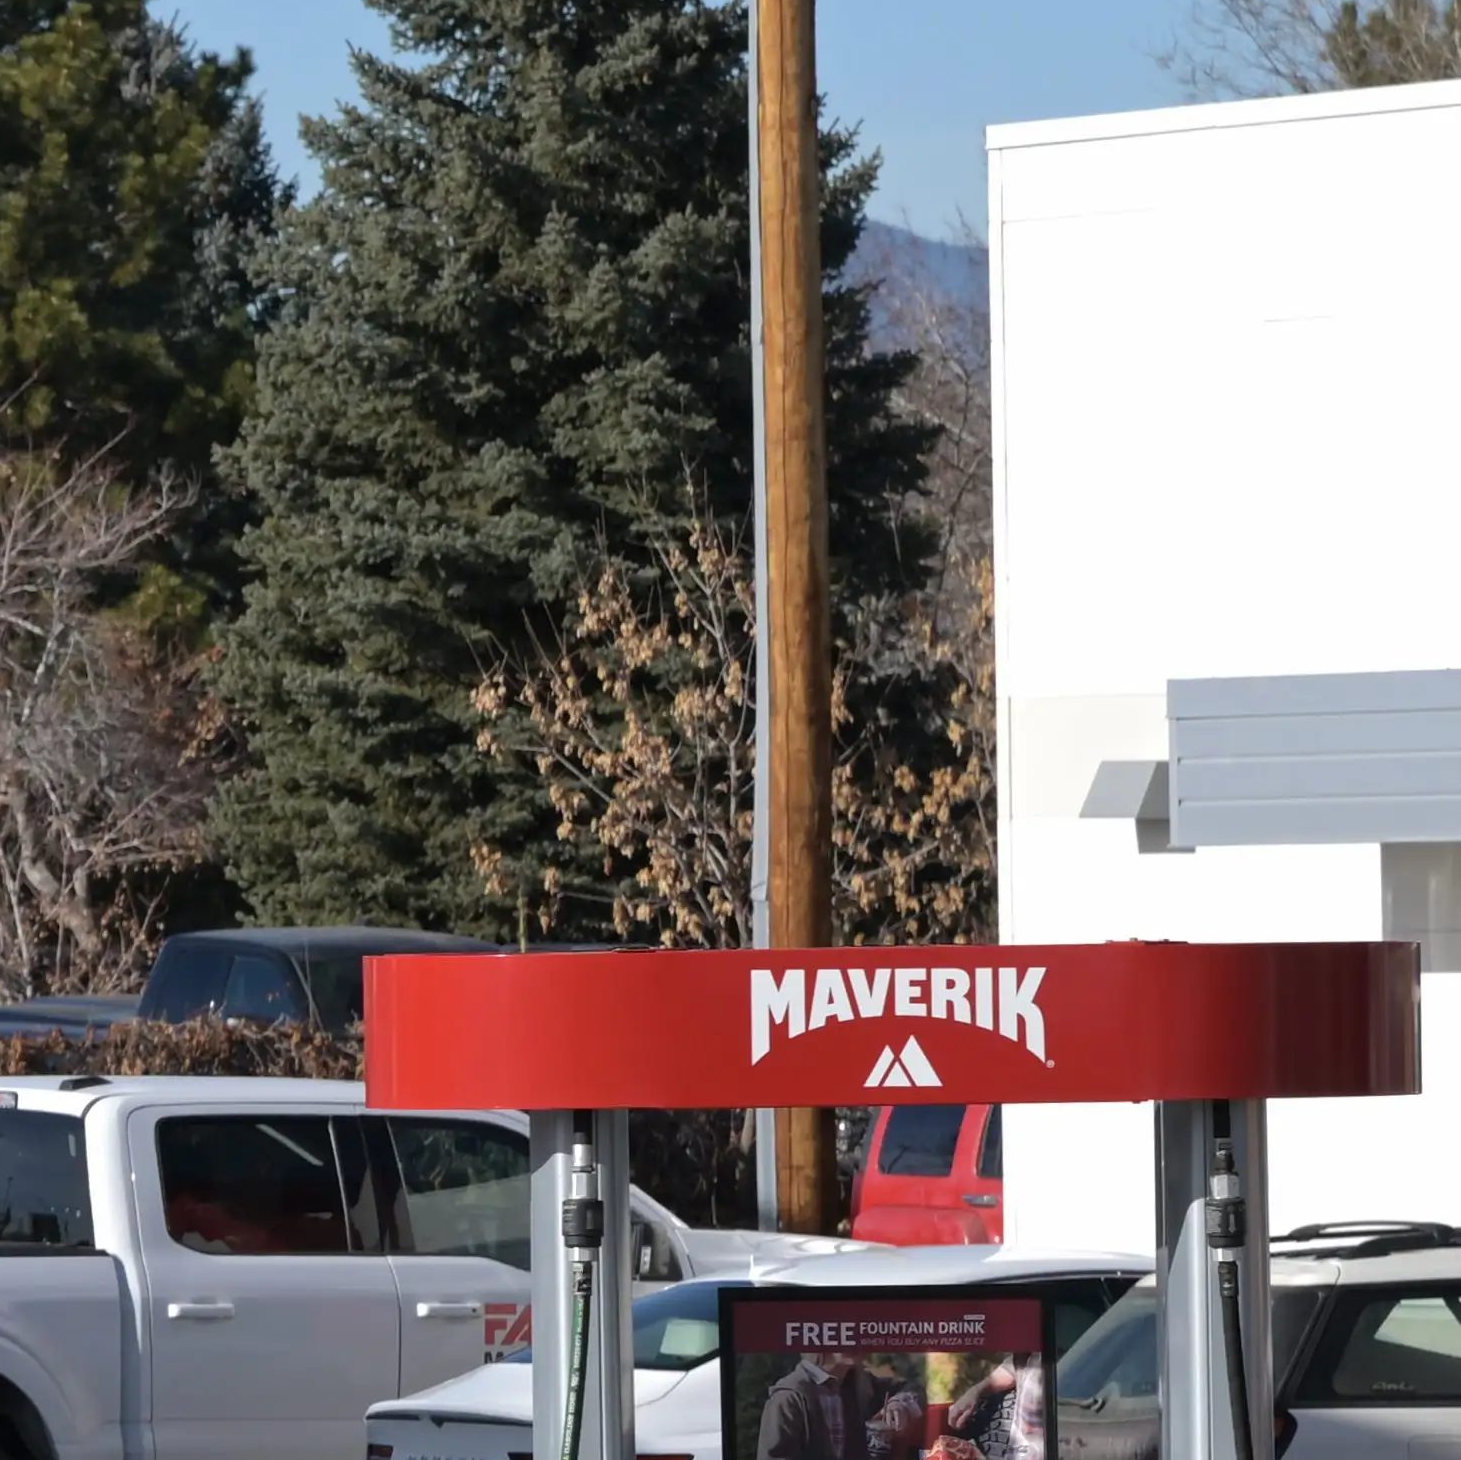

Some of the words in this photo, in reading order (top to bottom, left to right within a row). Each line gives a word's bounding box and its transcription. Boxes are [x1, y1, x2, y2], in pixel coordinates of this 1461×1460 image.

[750, 966, 1049, 1065] MAVERIK
[485, 1303, 532, 1345] FA
[786, 1322, 856, 1346] FREE
[859, 1321, 934, 1335] FOUNTAIN
[938, 1321, 986, 1334] DRINK
[921, 1337, 940, 1346] ANY
